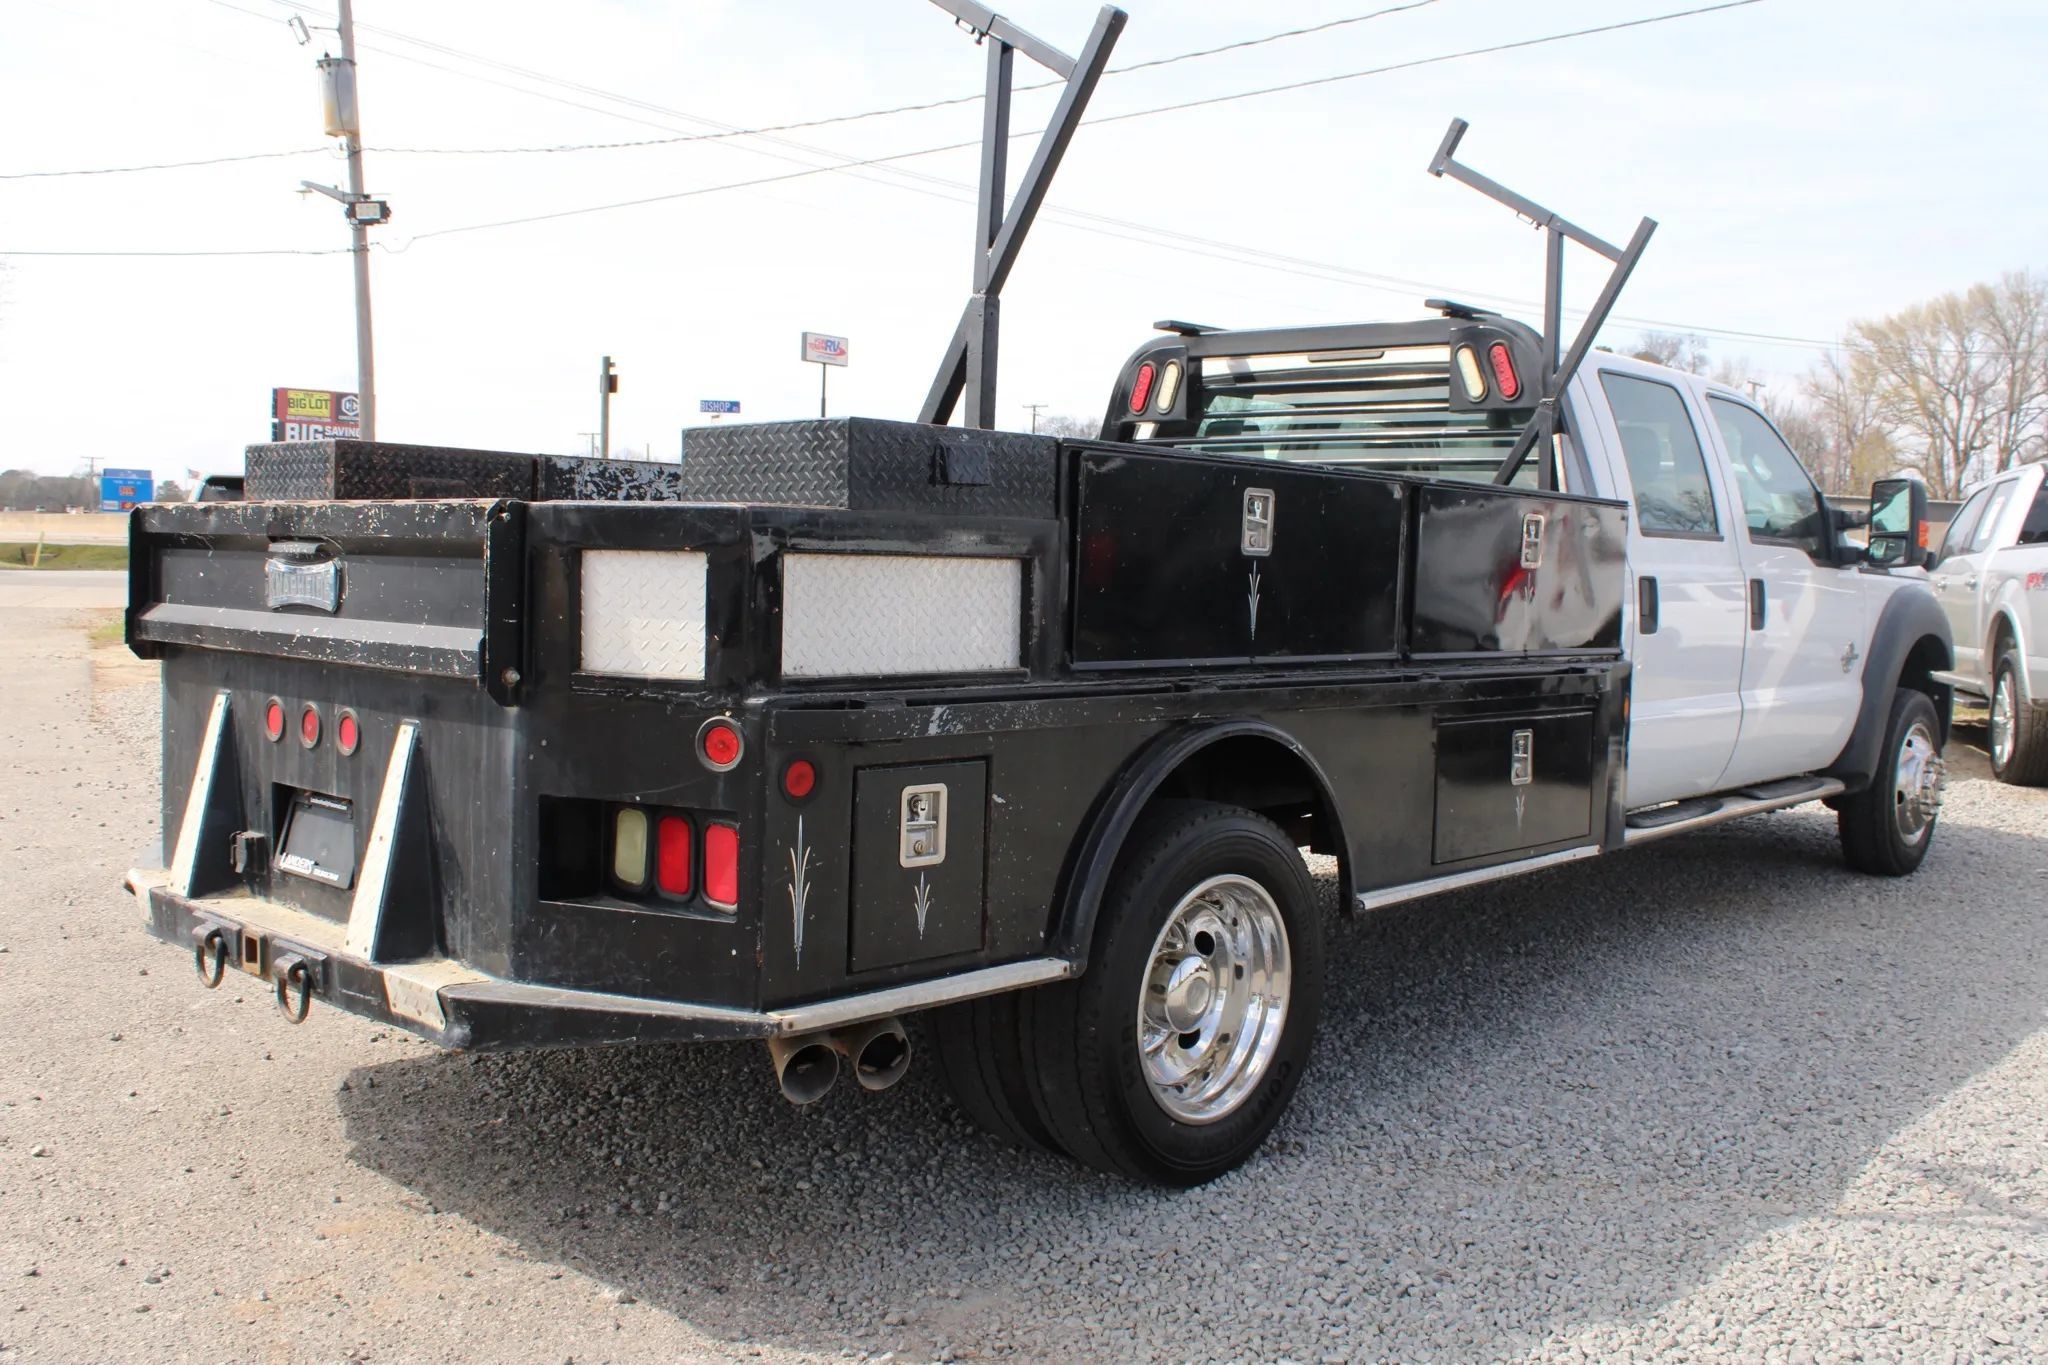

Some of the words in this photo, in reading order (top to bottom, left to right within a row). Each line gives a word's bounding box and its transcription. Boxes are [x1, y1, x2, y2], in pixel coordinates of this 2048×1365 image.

[825, 339, 840, 352] RV
[288, 398, 307, 409] BIG
[309, 399, 330, 410] LOT
[700, 401, 730, 412] BISHOP
[285, 422, 324, 441] BIG
